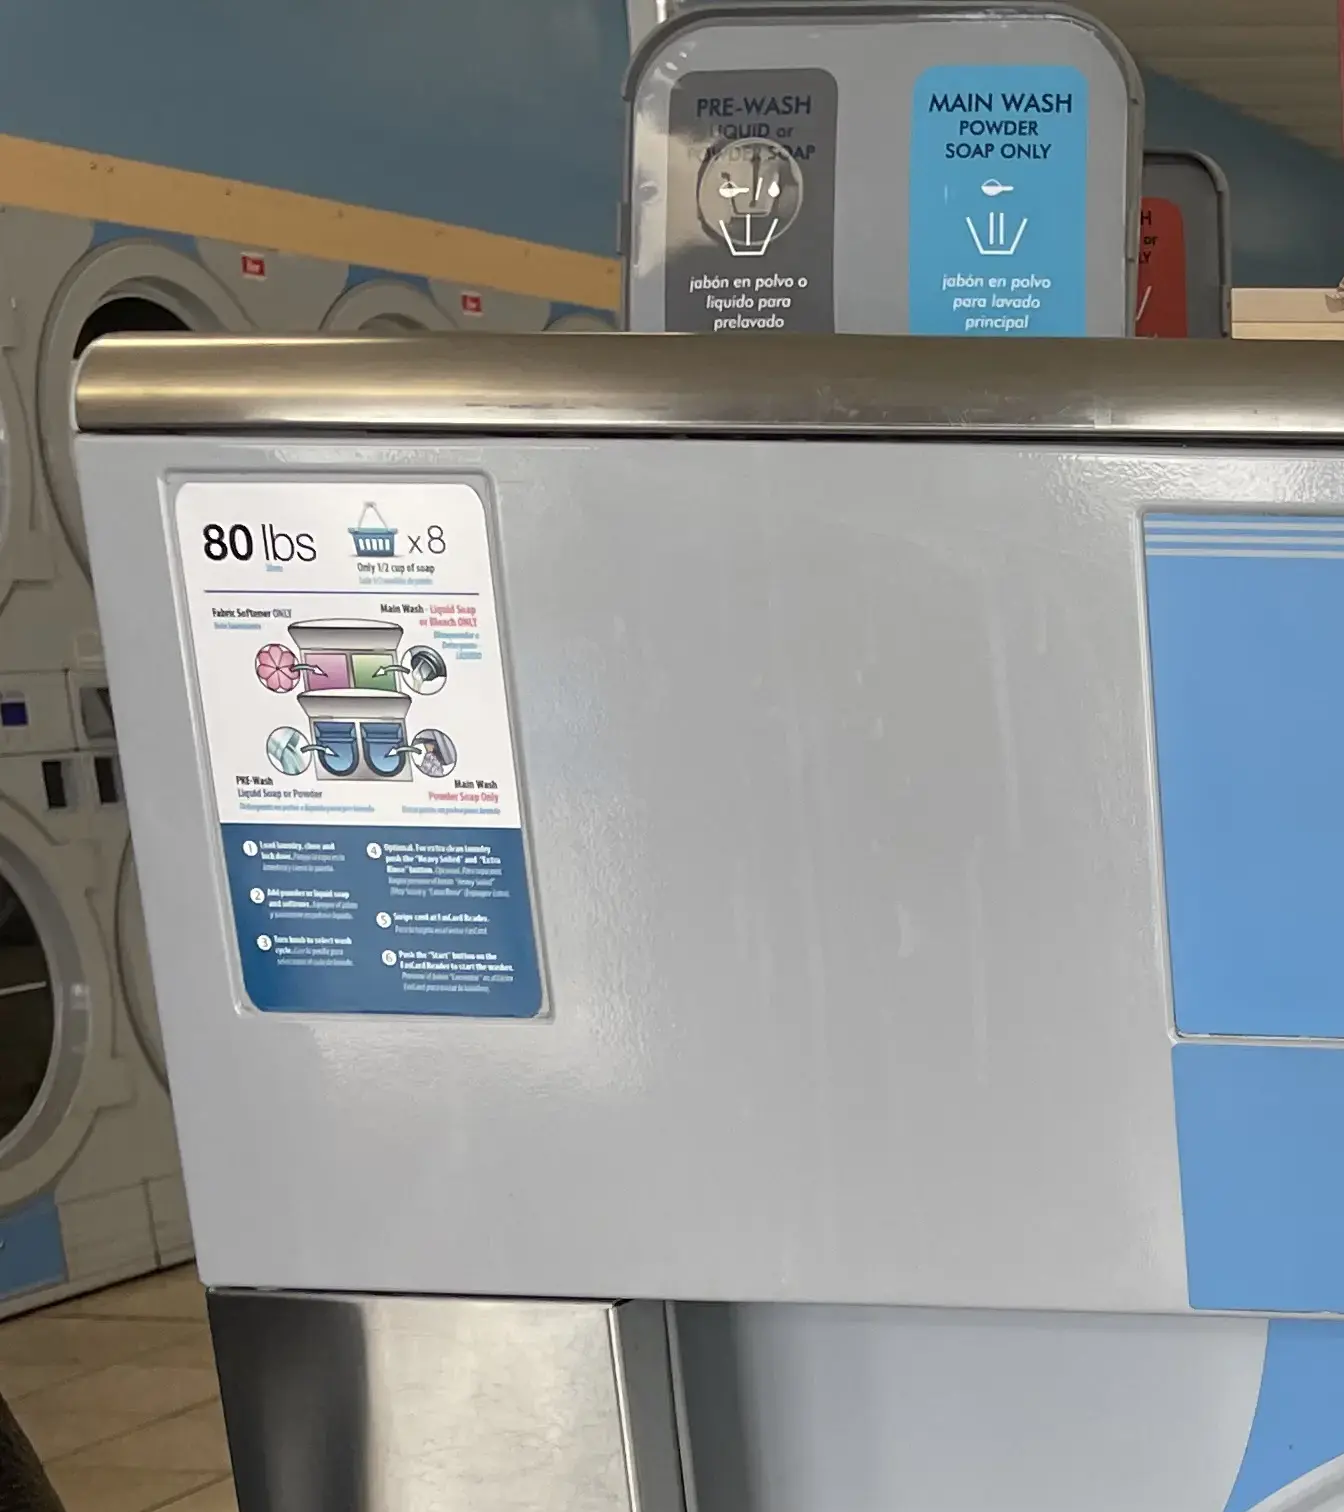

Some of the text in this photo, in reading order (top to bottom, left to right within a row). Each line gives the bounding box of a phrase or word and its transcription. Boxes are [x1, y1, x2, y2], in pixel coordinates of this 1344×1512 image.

[697, 95, 811, 117] PRE-WASH
[929, 93, 1073, 113] MAIN WASH
[710, 124, 794, 139] LIQUID or
[959, 119, 1038, 136] POWDER
[945, 143, 1051, 160] SOAP ONLY
[690, 274, 808, 292] jabón en polvo o
[942, 274, 1051, 291] jabón en polvo
[758, 296, 791, 309] para
[953, 295, 1040, 310] para lavado
[713, 316, 784, 331] prelavado
[965, 315, 1028, 330] principal
[203, 524, 253, 561] 80
[261, 524, 317, 562] lbs
[357, 563, 435, 575] Only 1/2 cup of soap
[237, 609, 271, 618] Softener
[380, 604, 424, 613] Main Wash
[454, 780, 497, 789] Main Wash
